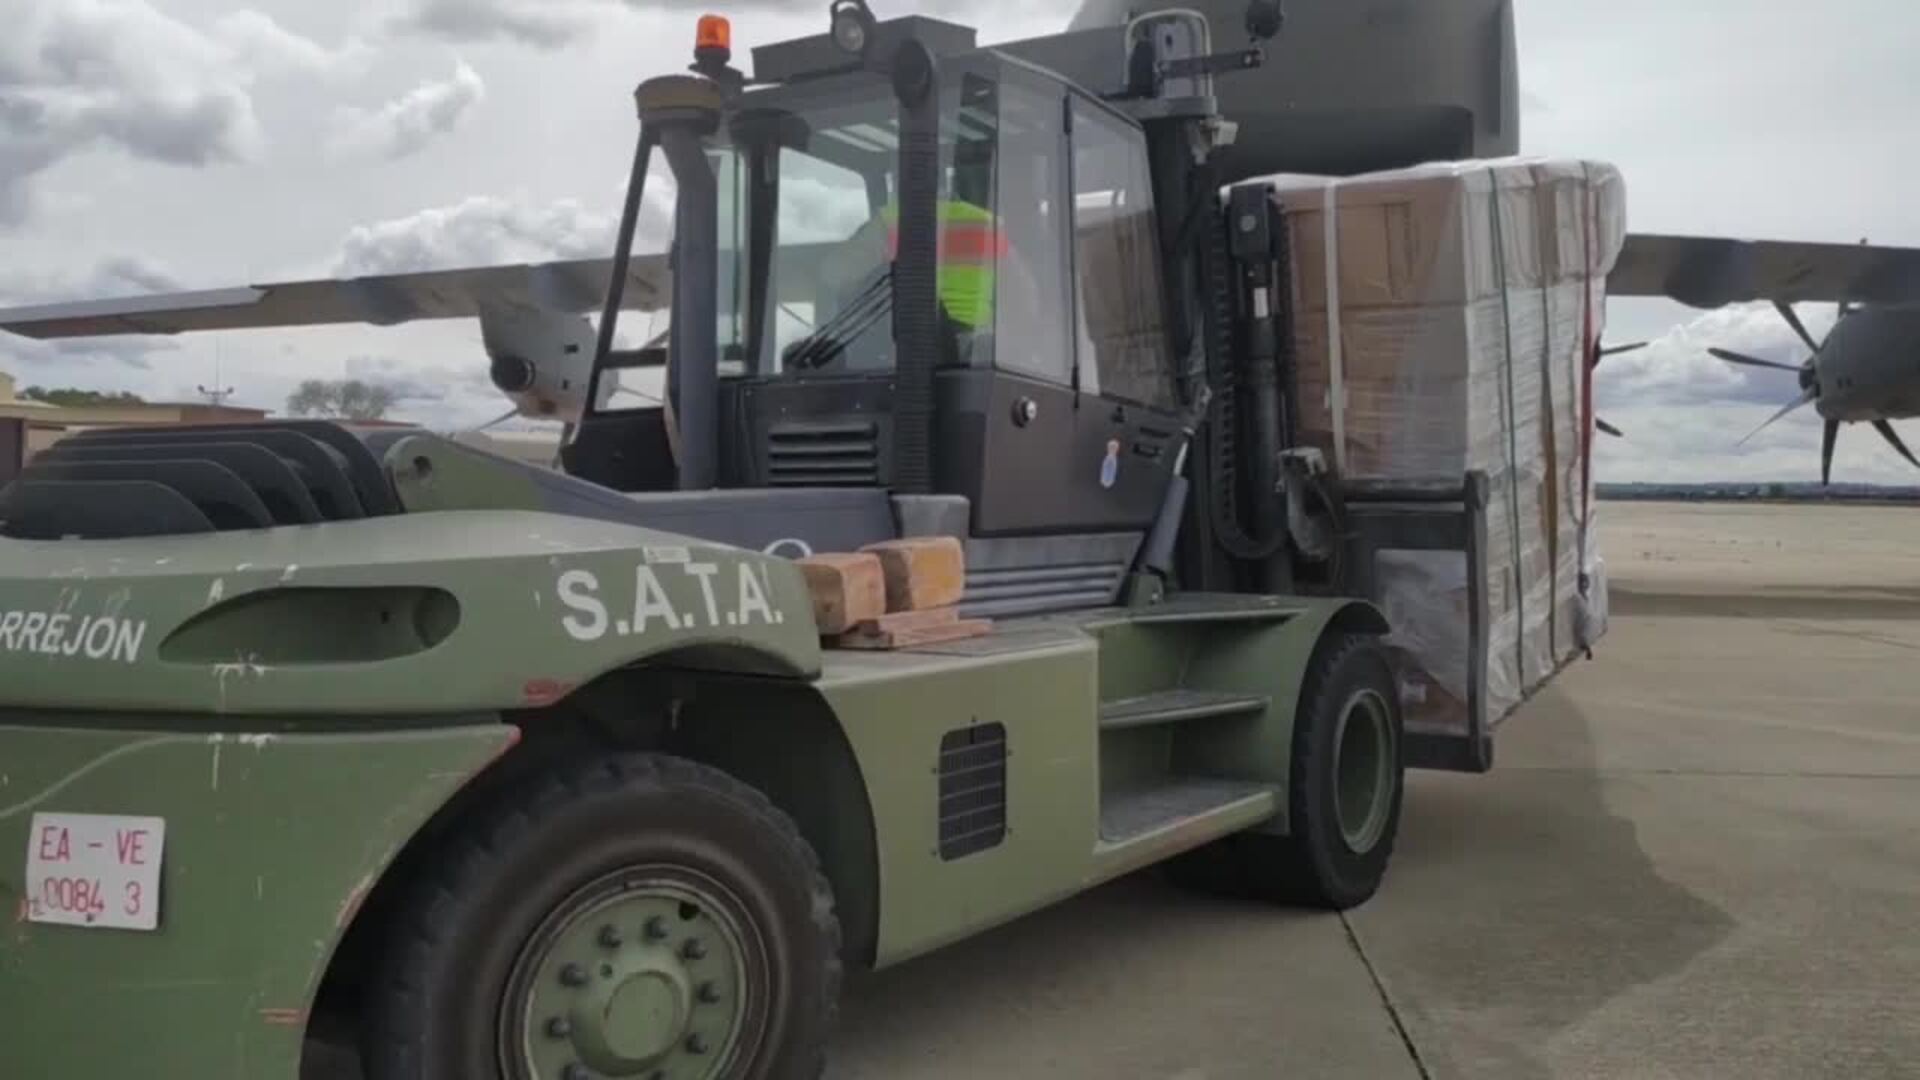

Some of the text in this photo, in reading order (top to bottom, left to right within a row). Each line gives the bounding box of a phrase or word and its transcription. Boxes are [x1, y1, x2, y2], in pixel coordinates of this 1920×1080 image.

[557, 563, 784, 640] S.A.T.A.
[0, 611, 146, 663] RREJON
[40, 826, 70, 861] EA
[117, 829, 149, 864] VE
[44, 877, 141, 915] 0084 3
